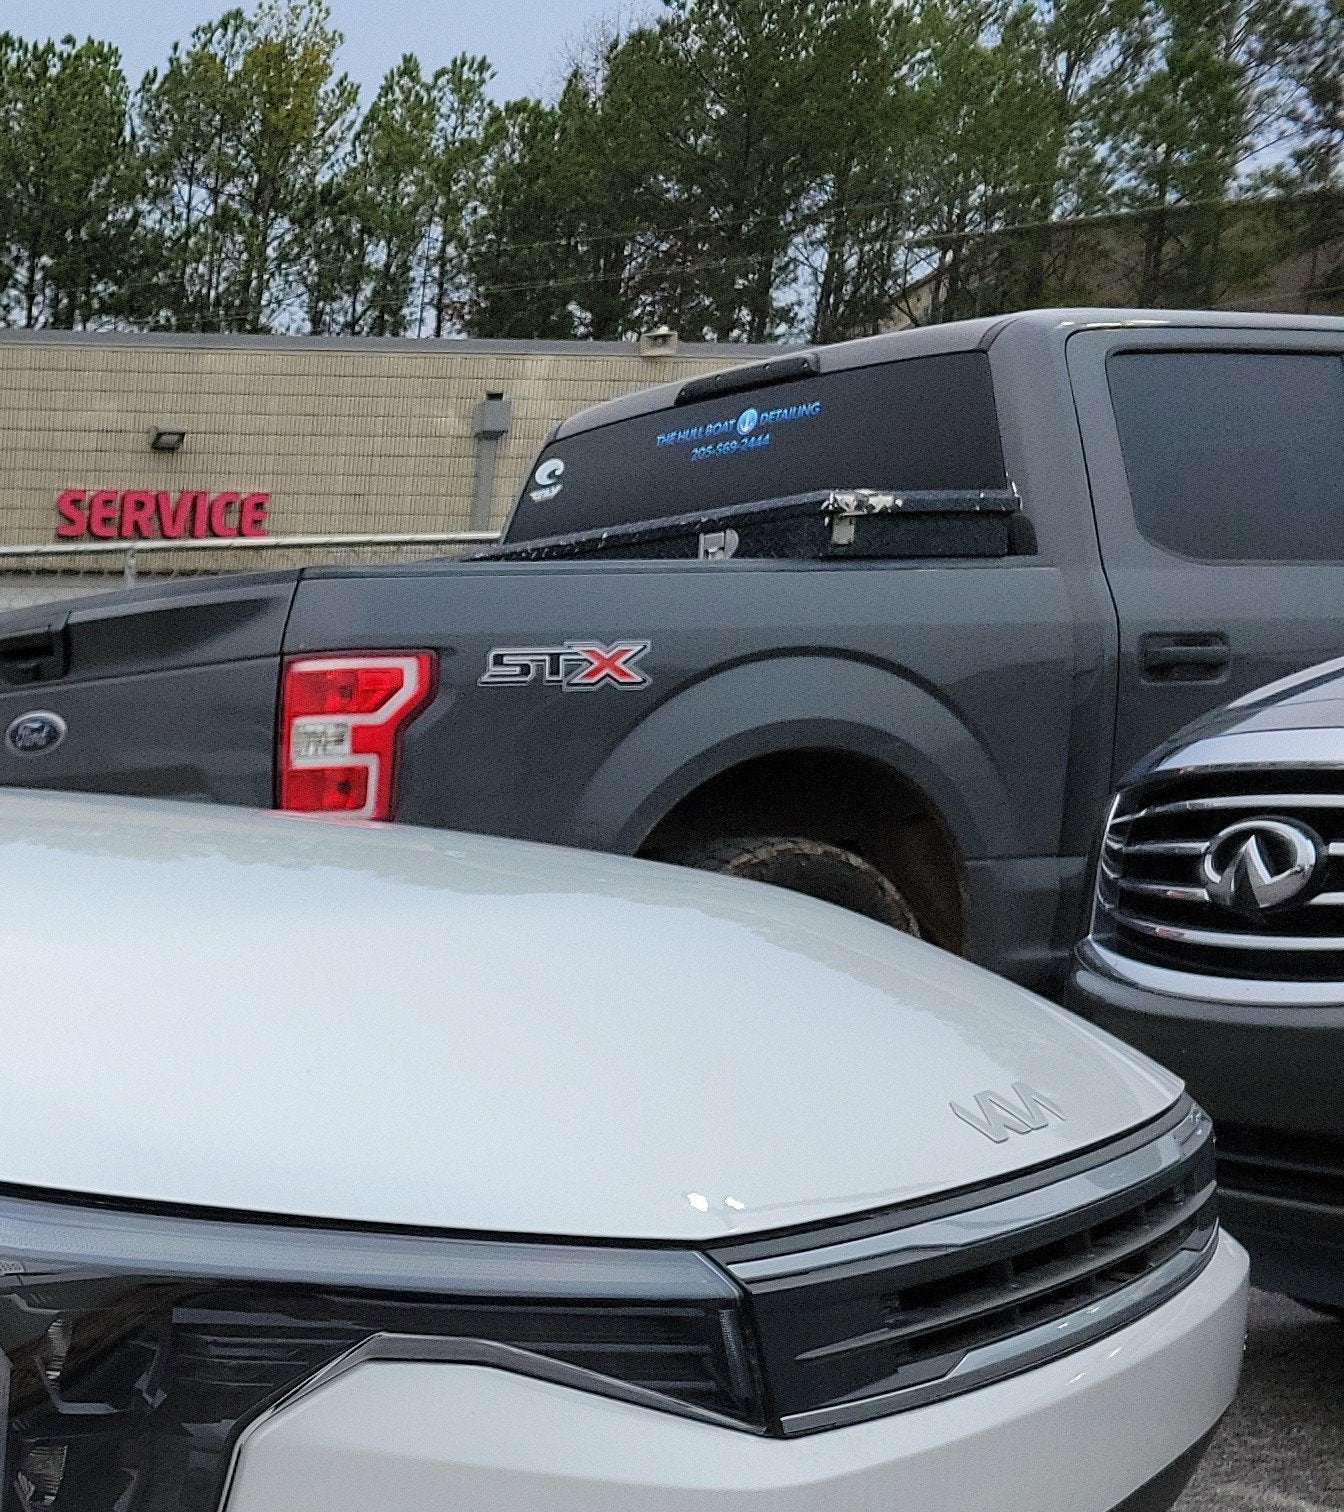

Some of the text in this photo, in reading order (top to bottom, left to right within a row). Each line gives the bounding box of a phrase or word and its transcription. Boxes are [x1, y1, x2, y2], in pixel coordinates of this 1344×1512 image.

[760, 401, 821, 425] DETAILING
[56, 488, 272, 539] SERVICE
[477, 639, 652, 692] STX
[949, 1080, 1066, 1145] KIA
